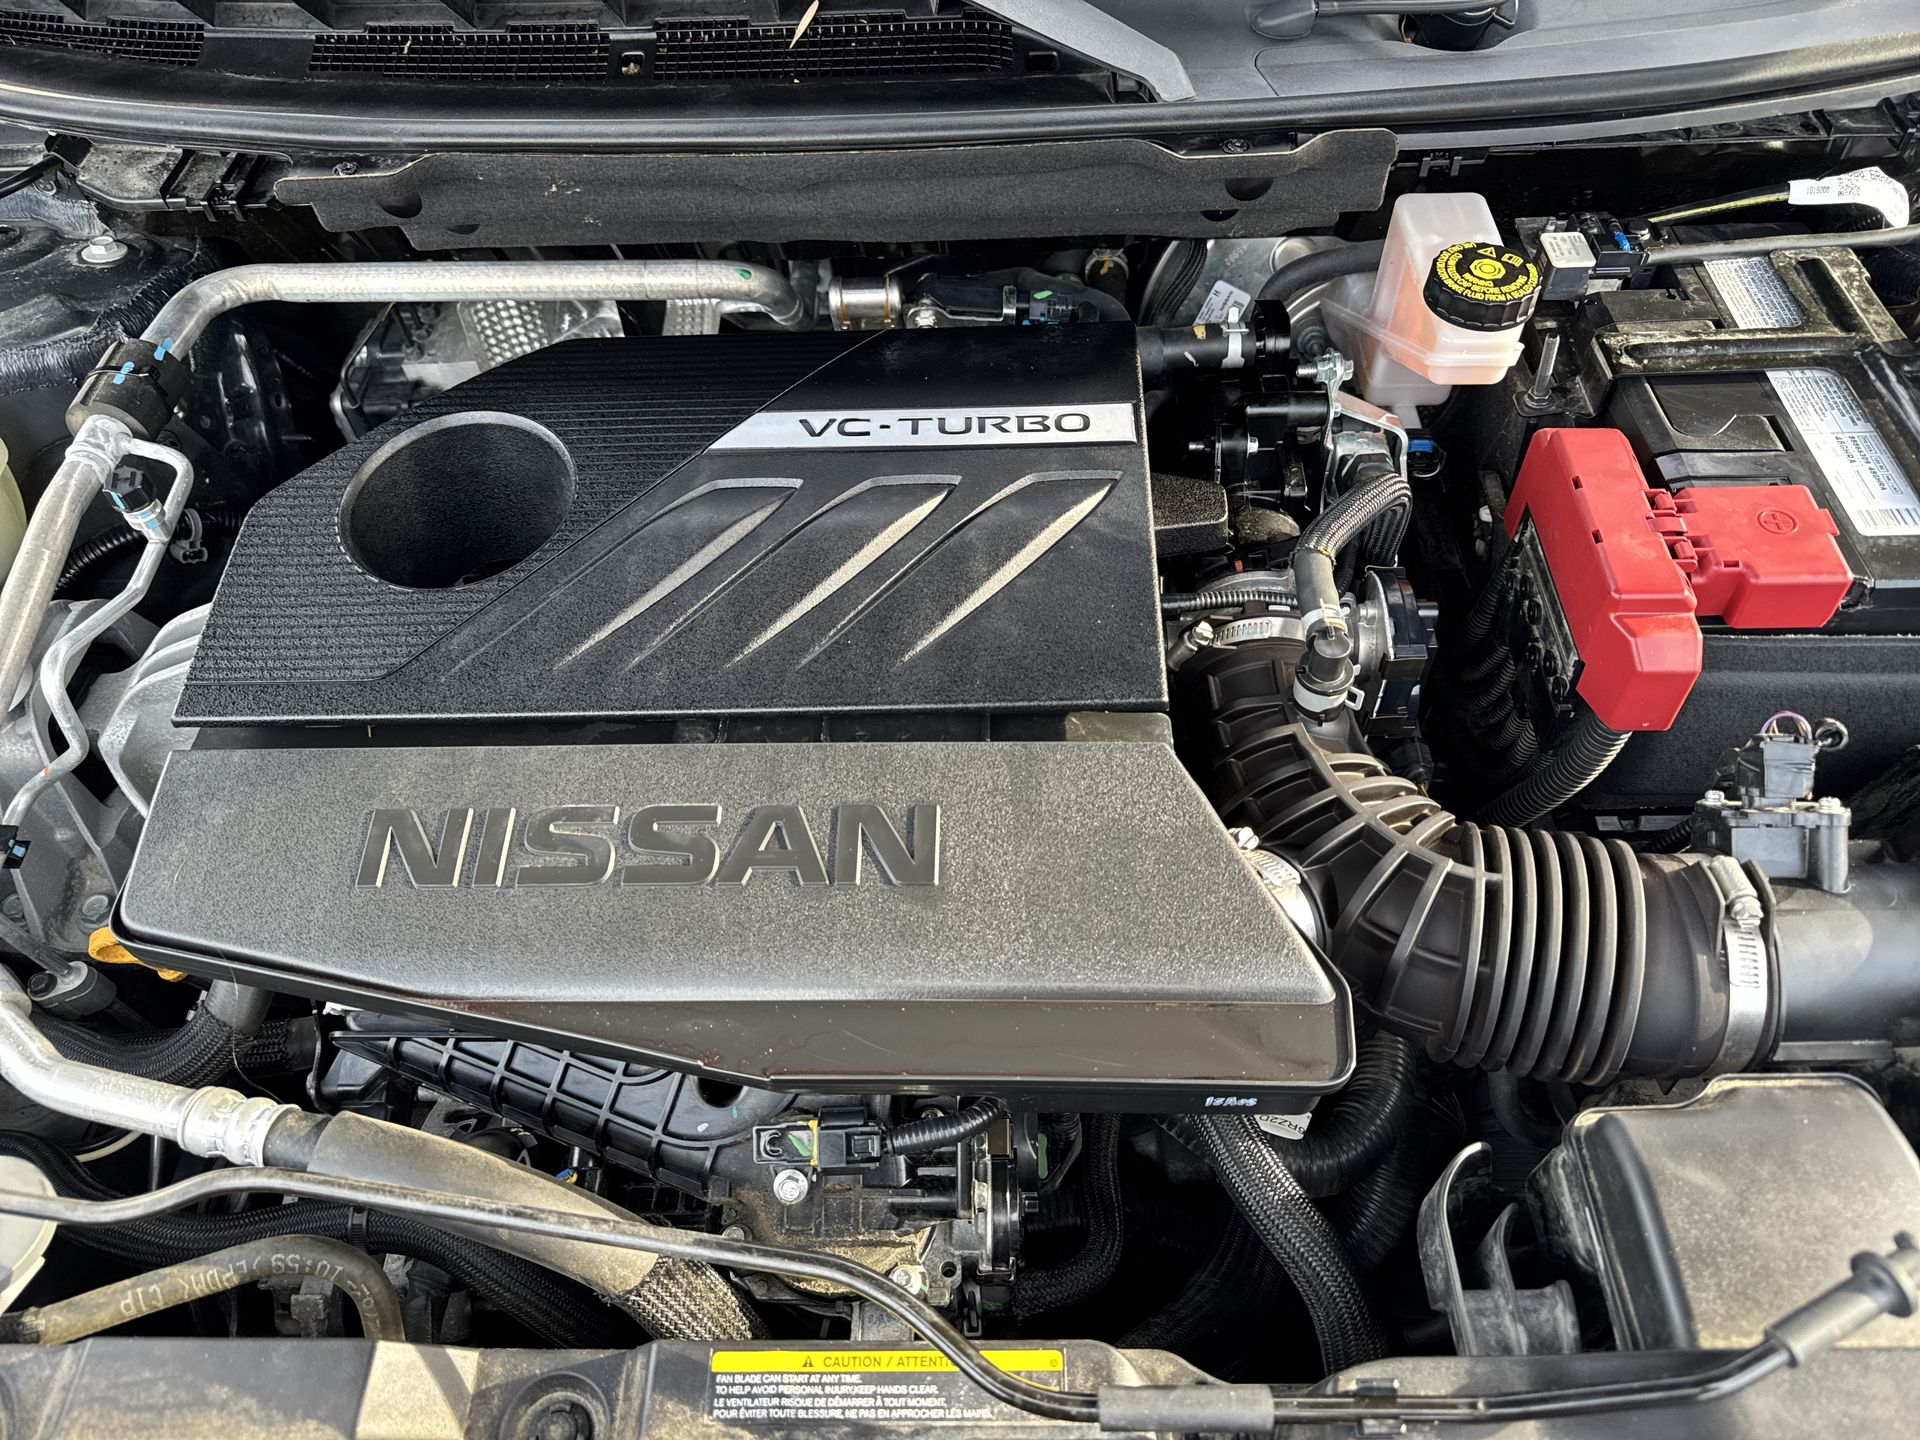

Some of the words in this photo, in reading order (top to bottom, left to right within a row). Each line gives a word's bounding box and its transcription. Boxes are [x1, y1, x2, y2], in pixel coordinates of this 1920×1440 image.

[1463, 289, 1485, 300] FLUID
[1485, 293, 1507, 301] FROM
[1471, 284, 1502, 294] BEFORE
[799, 413, 1091, 438] VC-TURBO
[356, 804, 940, 888] NISSAN
[823, 1356, 882, 1368] CAUTION
[716, 1375, 733, 1383] FAN
[734, 1375, 762, 1383] BLADE
[762, 1375, 781, 1383] CAN
[782, 1375, 809, 1383] START
[809, 1375, 820, 1383] AT
[821, 1375, 840, 1383] ANY
[840, 1375, 862, 1383] TIME.
[715, 1385, 728, 1394] TO
[729, 1385, 751, 1394] HELP
[751, 1385, 777, 1394] AVOID
[778, 1385, 824, 1394] PERSONAL
[877, 1385, 908, 1394] HANDS
[908, 1385, 939, 1394] CLEAR.
[714, 1398, 725, 1407] LE
[726, 1398, 780, 1407] VENTILATEUR
[781, 1398, 813, 1407] RISQUE
[814, 1398, 828, 1407] DE
[828, 1396, 875, 1407] DÉMARRER
[875, 1395, 883, 1407] À
[883, 1398, 906, 1407] TOUT
[713, 1409, 738, 1418] POUR
[739, 1406, 768, 1418] ÉVITER
[768, 1409, 797, 1418] TOUTE
[845, 1409, 858, 1418] NE
[858, 1409, 876, 1418] PAS
[877, 1409, 890, 1418] EN
[890, 1409, 945, 1418] APPROCHER
[946, 1409, 962, 1418] LES
